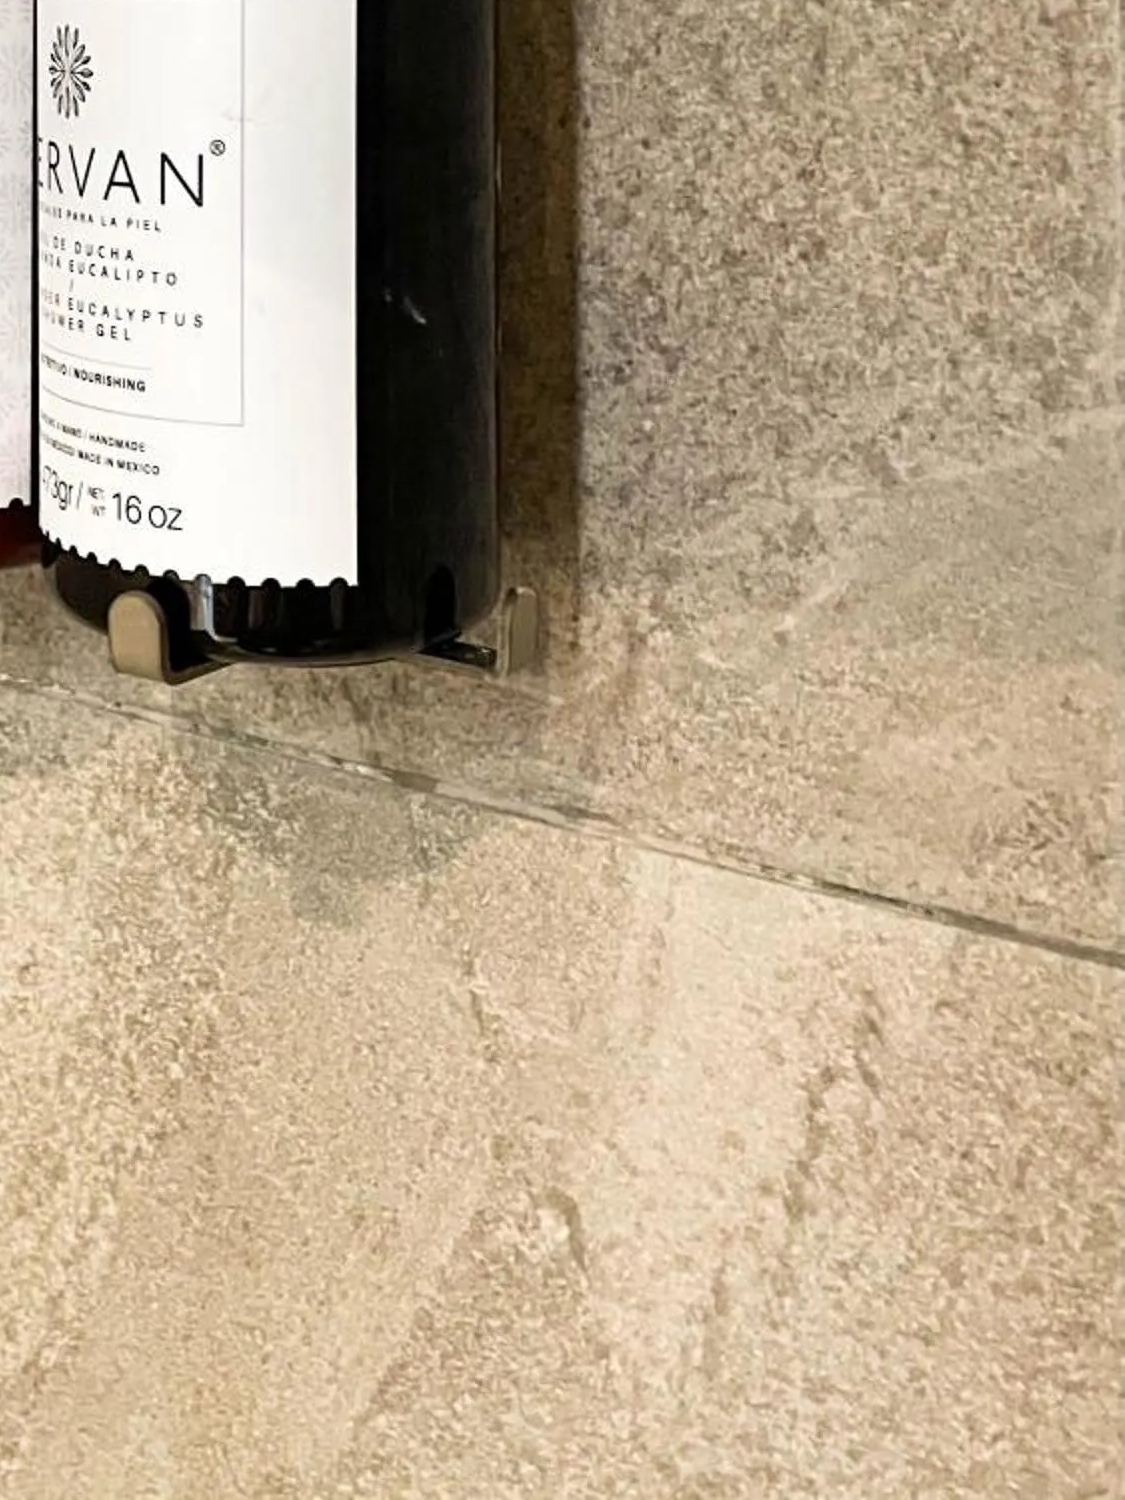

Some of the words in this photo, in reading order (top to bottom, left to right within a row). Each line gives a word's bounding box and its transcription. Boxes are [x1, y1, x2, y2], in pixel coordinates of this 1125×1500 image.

[101, 215, 117, 228] LA
[126, 217, 161, 232] PIEL
[74, 241, 134, 261] DUCHA
[69, 259, 178, 286] EUCALIPTO
[68, 297, 204, 329] EUCALYPTUS
[96, 323, 131, 341] GEL
[74, 367, 146, 392] NOURISHING
[89, 434, 146, 453] HANDMADE
[117, 459, 160, 475] MEXICO
[42, 465, 73, 511] 73gr
[112, 492, 142, 524] 16
[148, 505, 183, 531] oz
